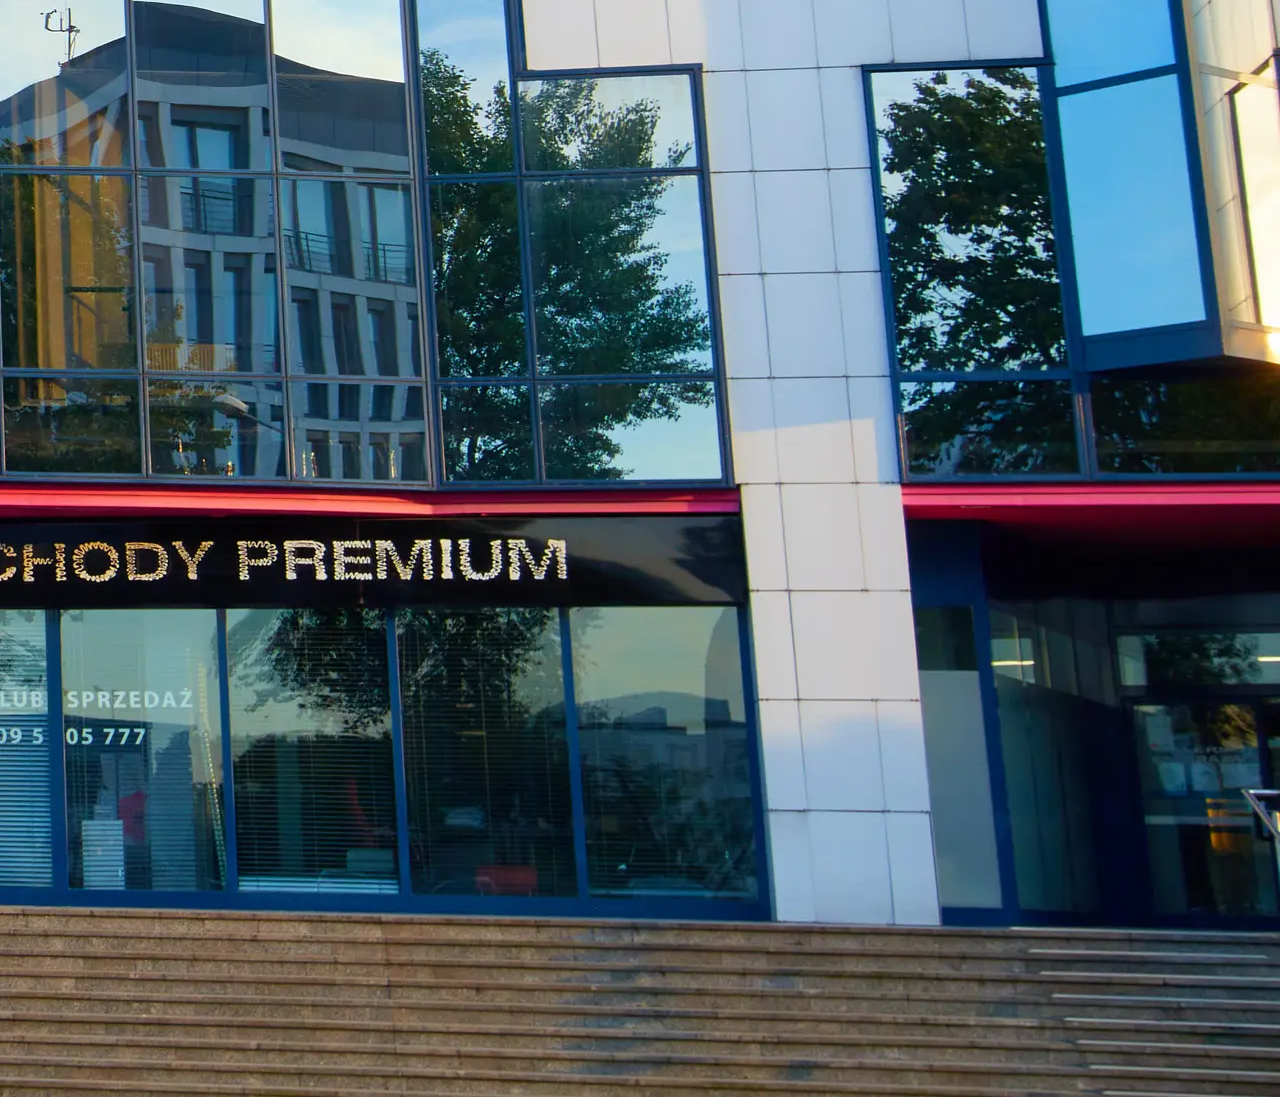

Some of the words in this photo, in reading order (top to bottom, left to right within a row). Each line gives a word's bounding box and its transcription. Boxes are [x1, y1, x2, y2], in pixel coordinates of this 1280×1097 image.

[237, 538, 568, 581] PREMIUM
[0, 690, 45, 708] LUB
[66, 687, 194, 709] SPRZEDAŻ
[103, 727, 146, 745] 777
